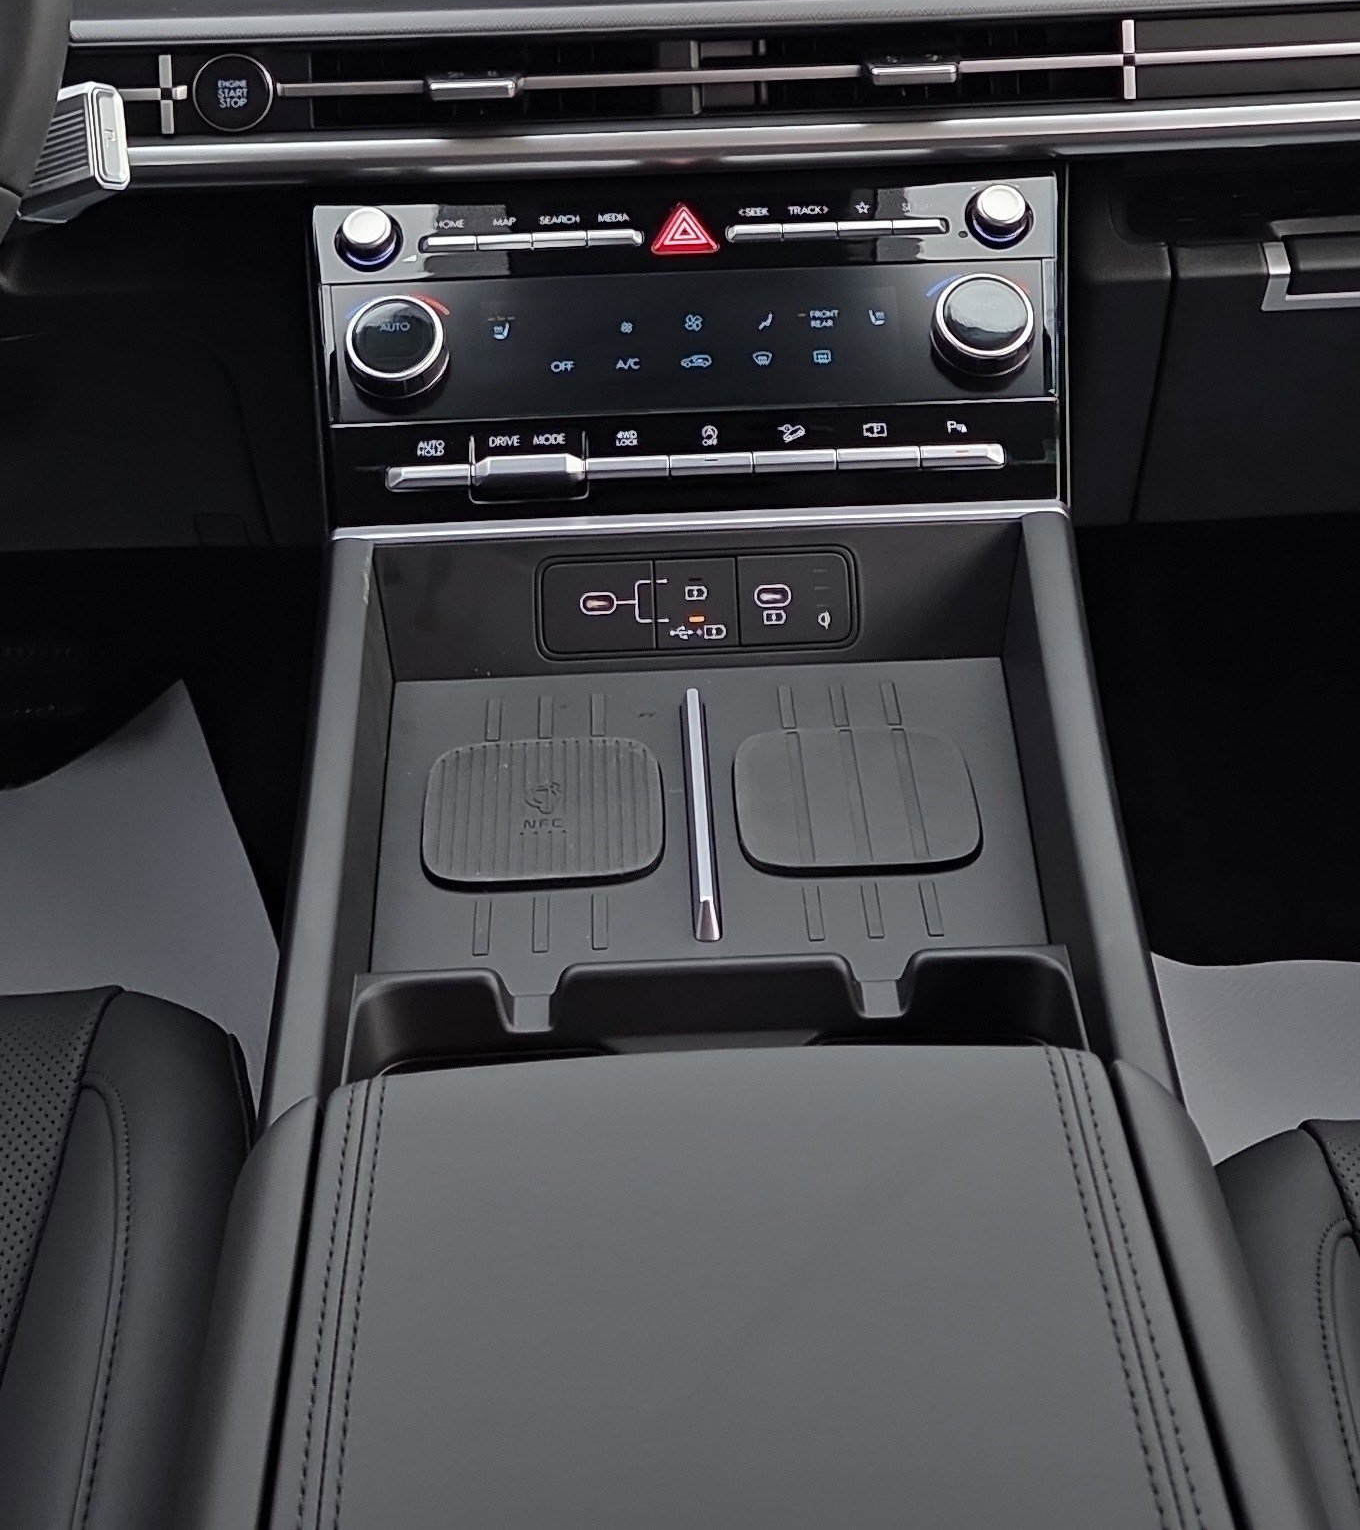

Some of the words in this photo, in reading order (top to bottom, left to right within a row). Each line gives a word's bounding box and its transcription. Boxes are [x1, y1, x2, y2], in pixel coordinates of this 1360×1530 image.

[217, 79, 247, 89] ENGINE
[217, 88, 248, 99] START
[219, 97, 248, 109] STOP
[492, 216, 517, 227] MAP
[538, 213, 581, 226] SEARCH
[597, 212, 631, 223] MEDIA
[809, 309, 839, 319] FRONT
[379, 321, 411, 332] AUTO
[810, 318, 834, 328] REAR
[550, 360, 575, 373] OFF
[615, 357, 641, 371] A/C
[417, 439, 445, 448] AUTO
[489, 434, 521, 448] DRIVE
[533, 432, 566, 446] MODE
[615, 438, 639, 447] LOCK
[416, 446, 445, 457] HOLD
[523, 817, 562, 830] NFC
